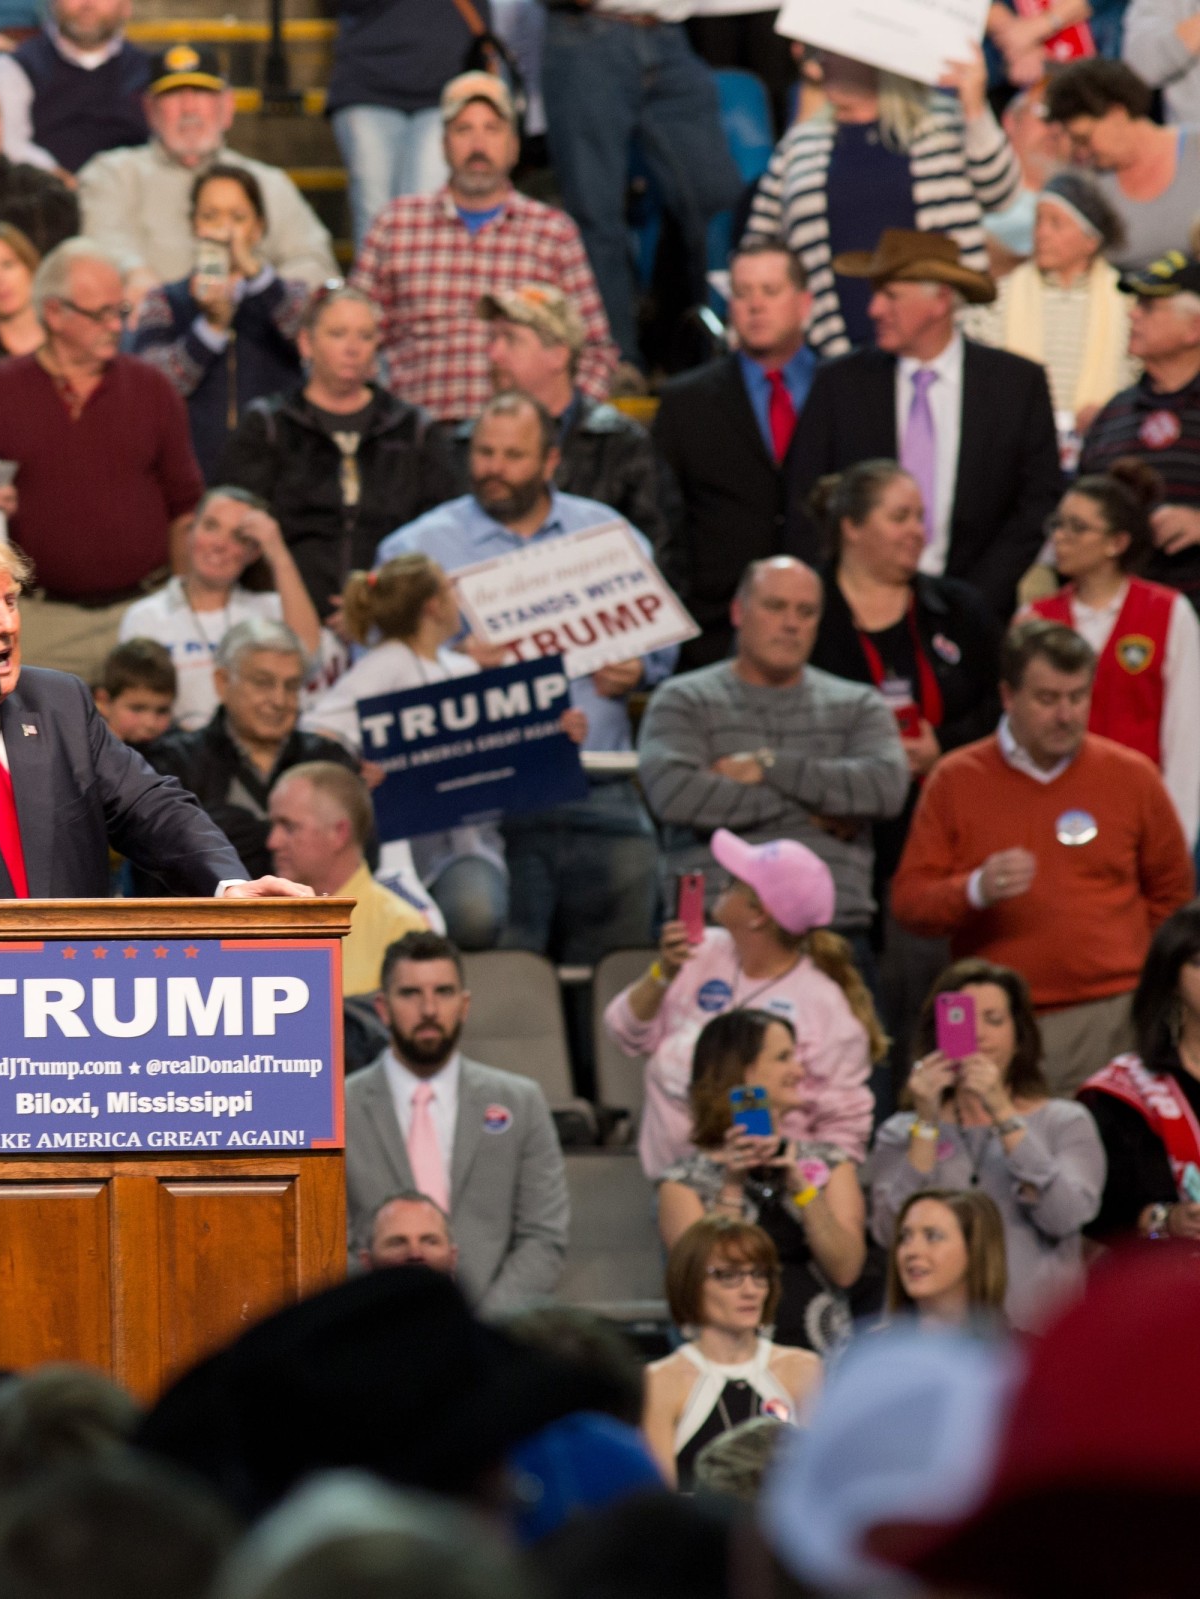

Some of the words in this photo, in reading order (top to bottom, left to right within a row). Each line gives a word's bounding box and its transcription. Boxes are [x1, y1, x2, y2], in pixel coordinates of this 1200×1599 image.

[486, 591, 580, 633] STANDS
[584, 569, 646, 601] WITH
[500, 593, 662, 664] TRUMP
[361, 672, 569, 749] TRUMP
[146, 1055, 323, 1079] @realDonaldTrump
[15, 1092, 100, 1118] Biloxi,
[106, 1090, 254, 1118] Mississippi
[35, 1131, 143, 1149] AMERICA
[146, 1130, 223, 1148] GREAT
[226, 1129, 306, 1147] AGAIN!
